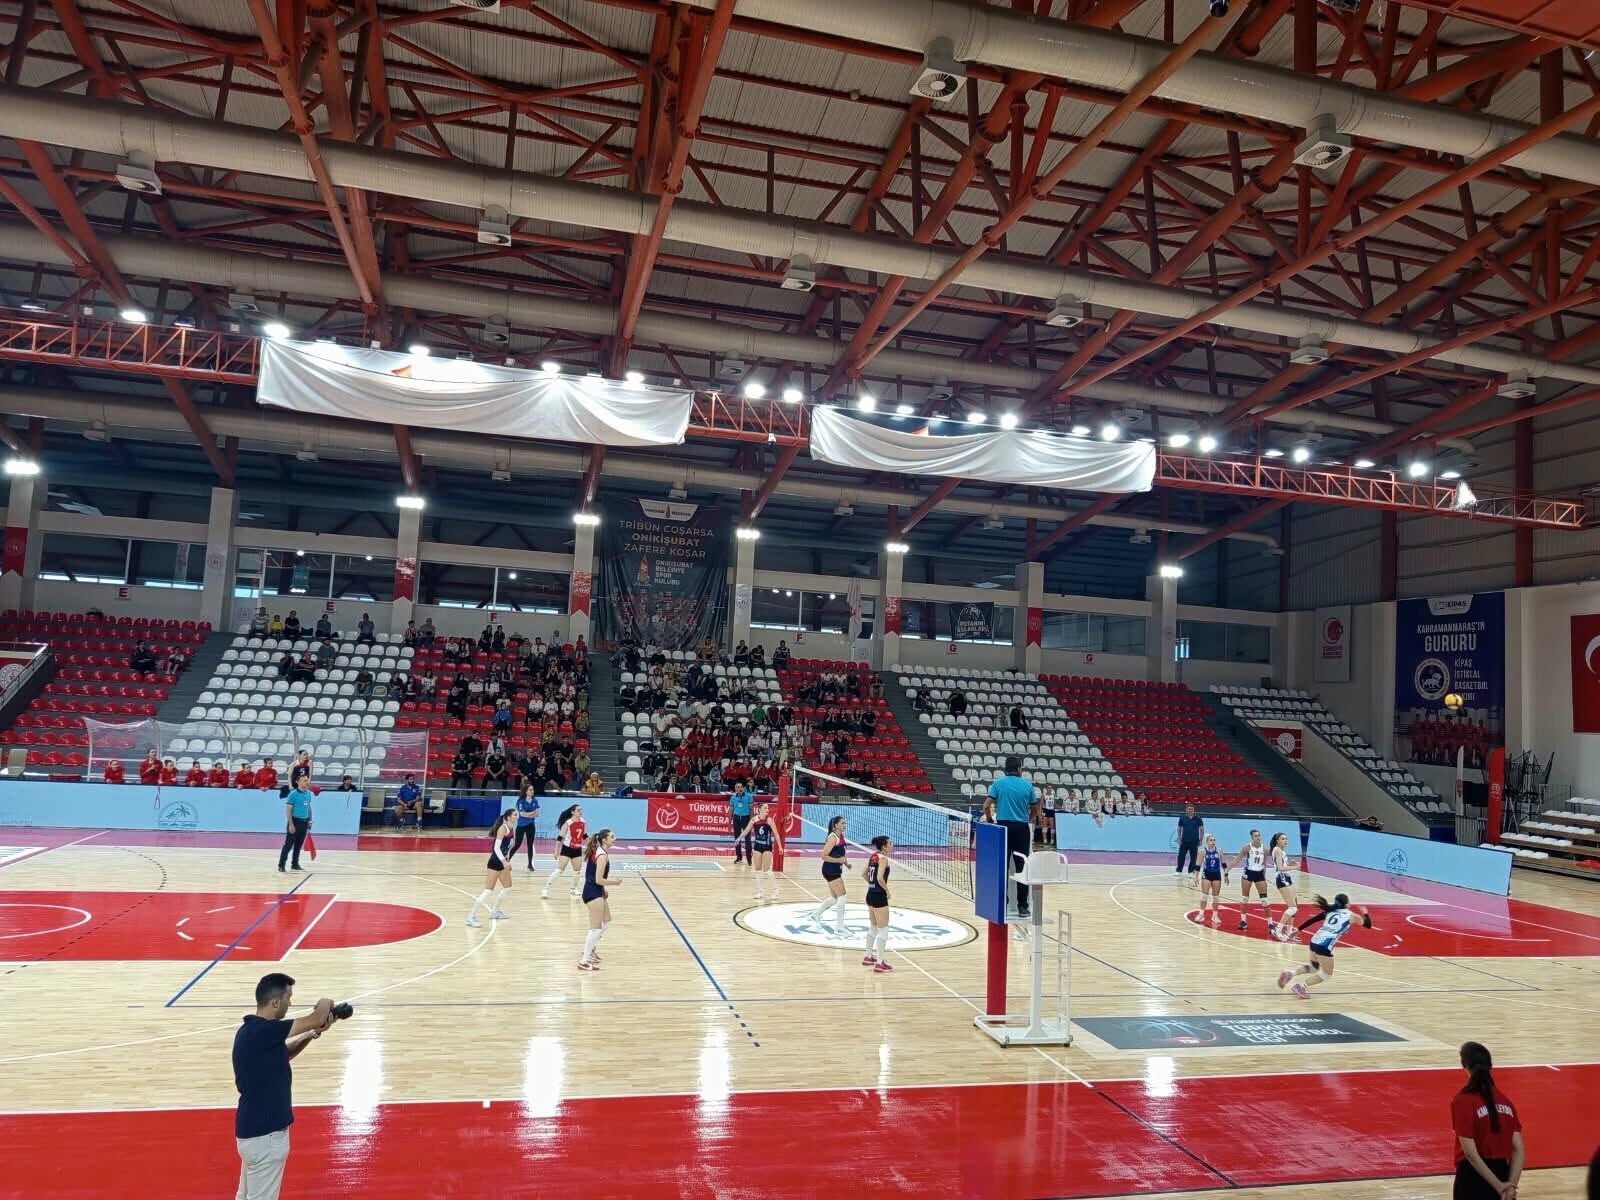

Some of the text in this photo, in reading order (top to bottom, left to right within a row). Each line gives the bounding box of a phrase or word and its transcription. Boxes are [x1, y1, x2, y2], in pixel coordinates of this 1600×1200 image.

[619, 519, 714, 537] TRİBÜN COŞARSA
[632, 532, 699, 547] ONİKİŞUBAT
[624, 543, 706, 559] ZAFERE KOŞAR
[119, 587, 128, 597] E
[326, 601, 335, 611] E
[490, 613, 497, 622] F
[796, 633, 803, 641] F
[1424, 633, 1477, 652] GURURU
[949, 644, 957, 652] G
[1086, 653, 1093, 661] G
[689, 802, 723, 813] TÜRKİYE
[575, 828, 583, 840] 7
[759, 825, 765, 835] 6
[1328, 913, 1342, 925] 6
